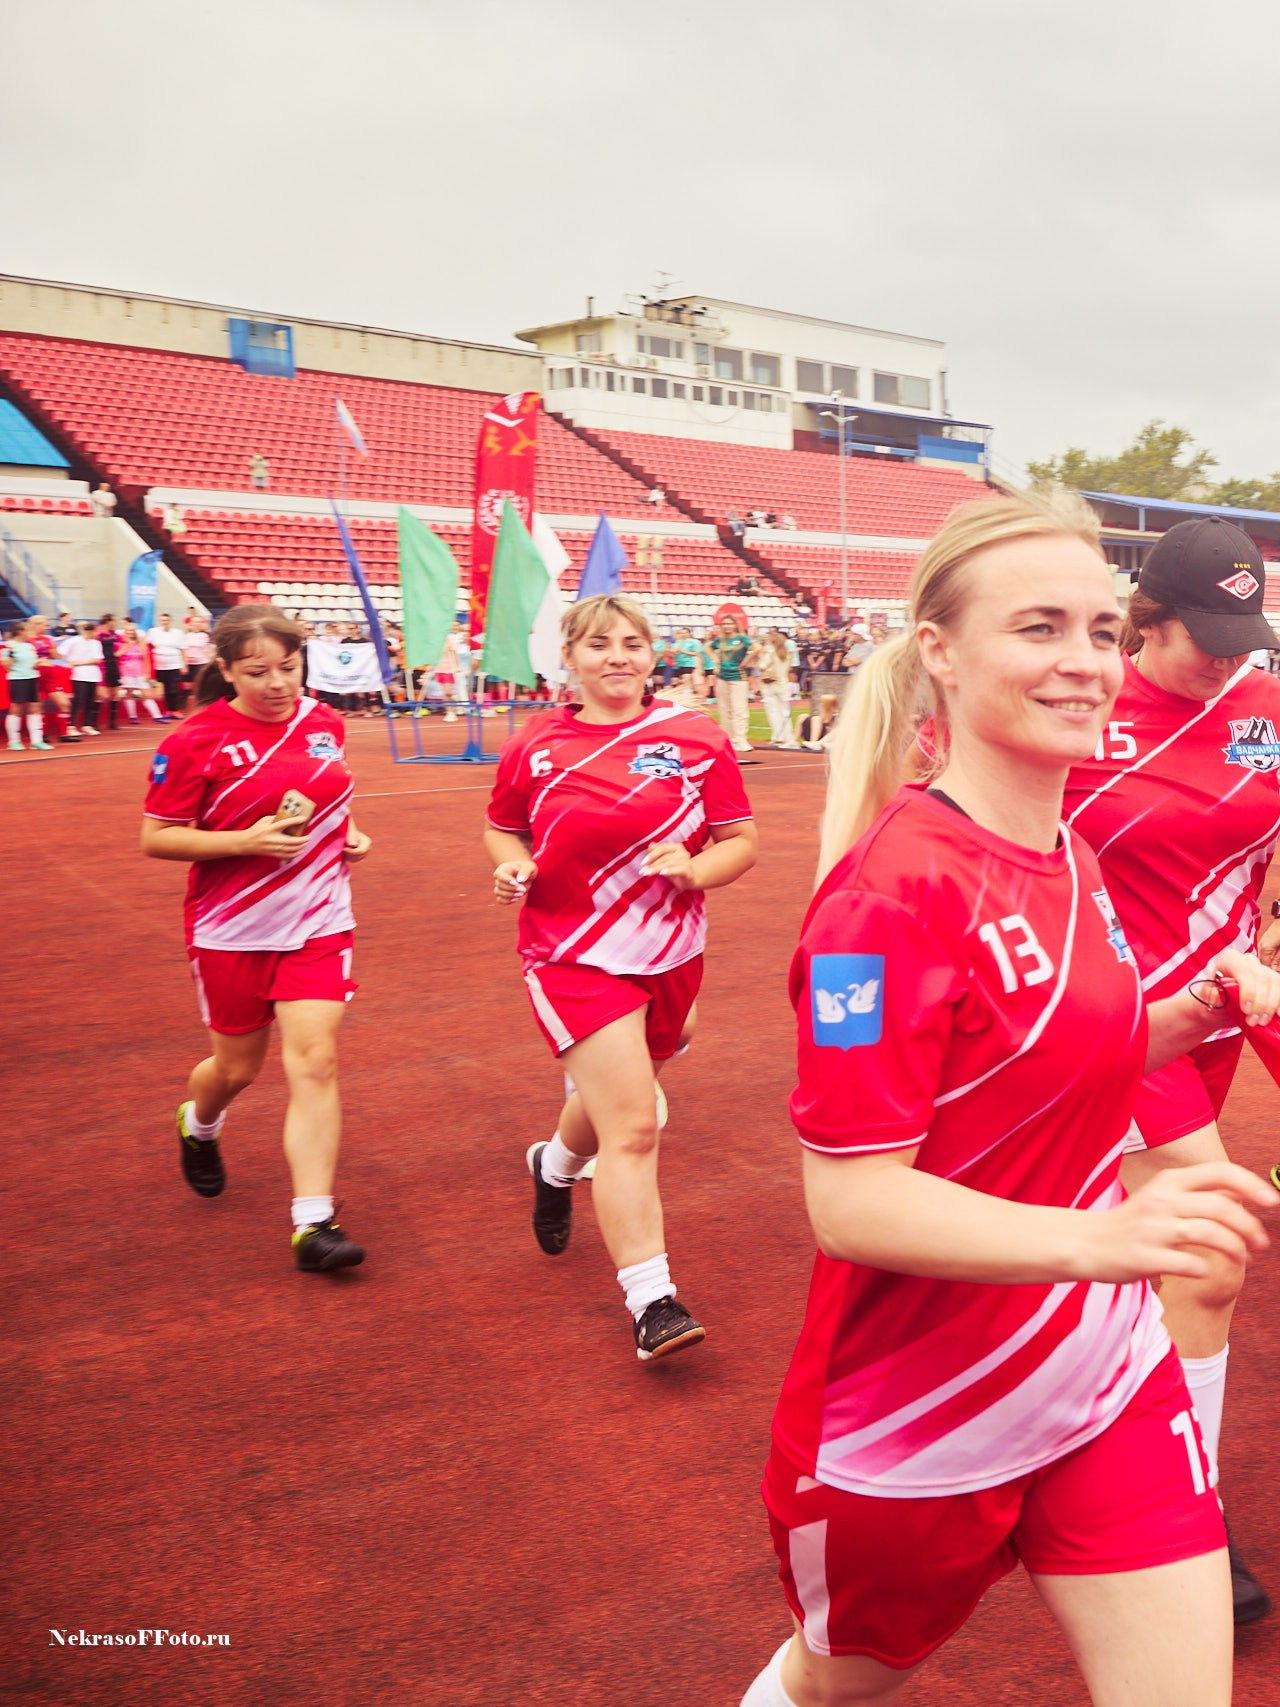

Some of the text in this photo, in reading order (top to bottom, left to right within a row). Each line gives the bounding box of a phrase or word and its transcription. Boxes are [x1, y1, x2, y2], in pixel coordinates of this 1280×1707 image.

[221, 739, 259, 767] 11
[529, 749, 553, 778] 6
[1235, 744, 1280, 755] ВАДЧАНКА
[978, 914, 1054, 994] 13
